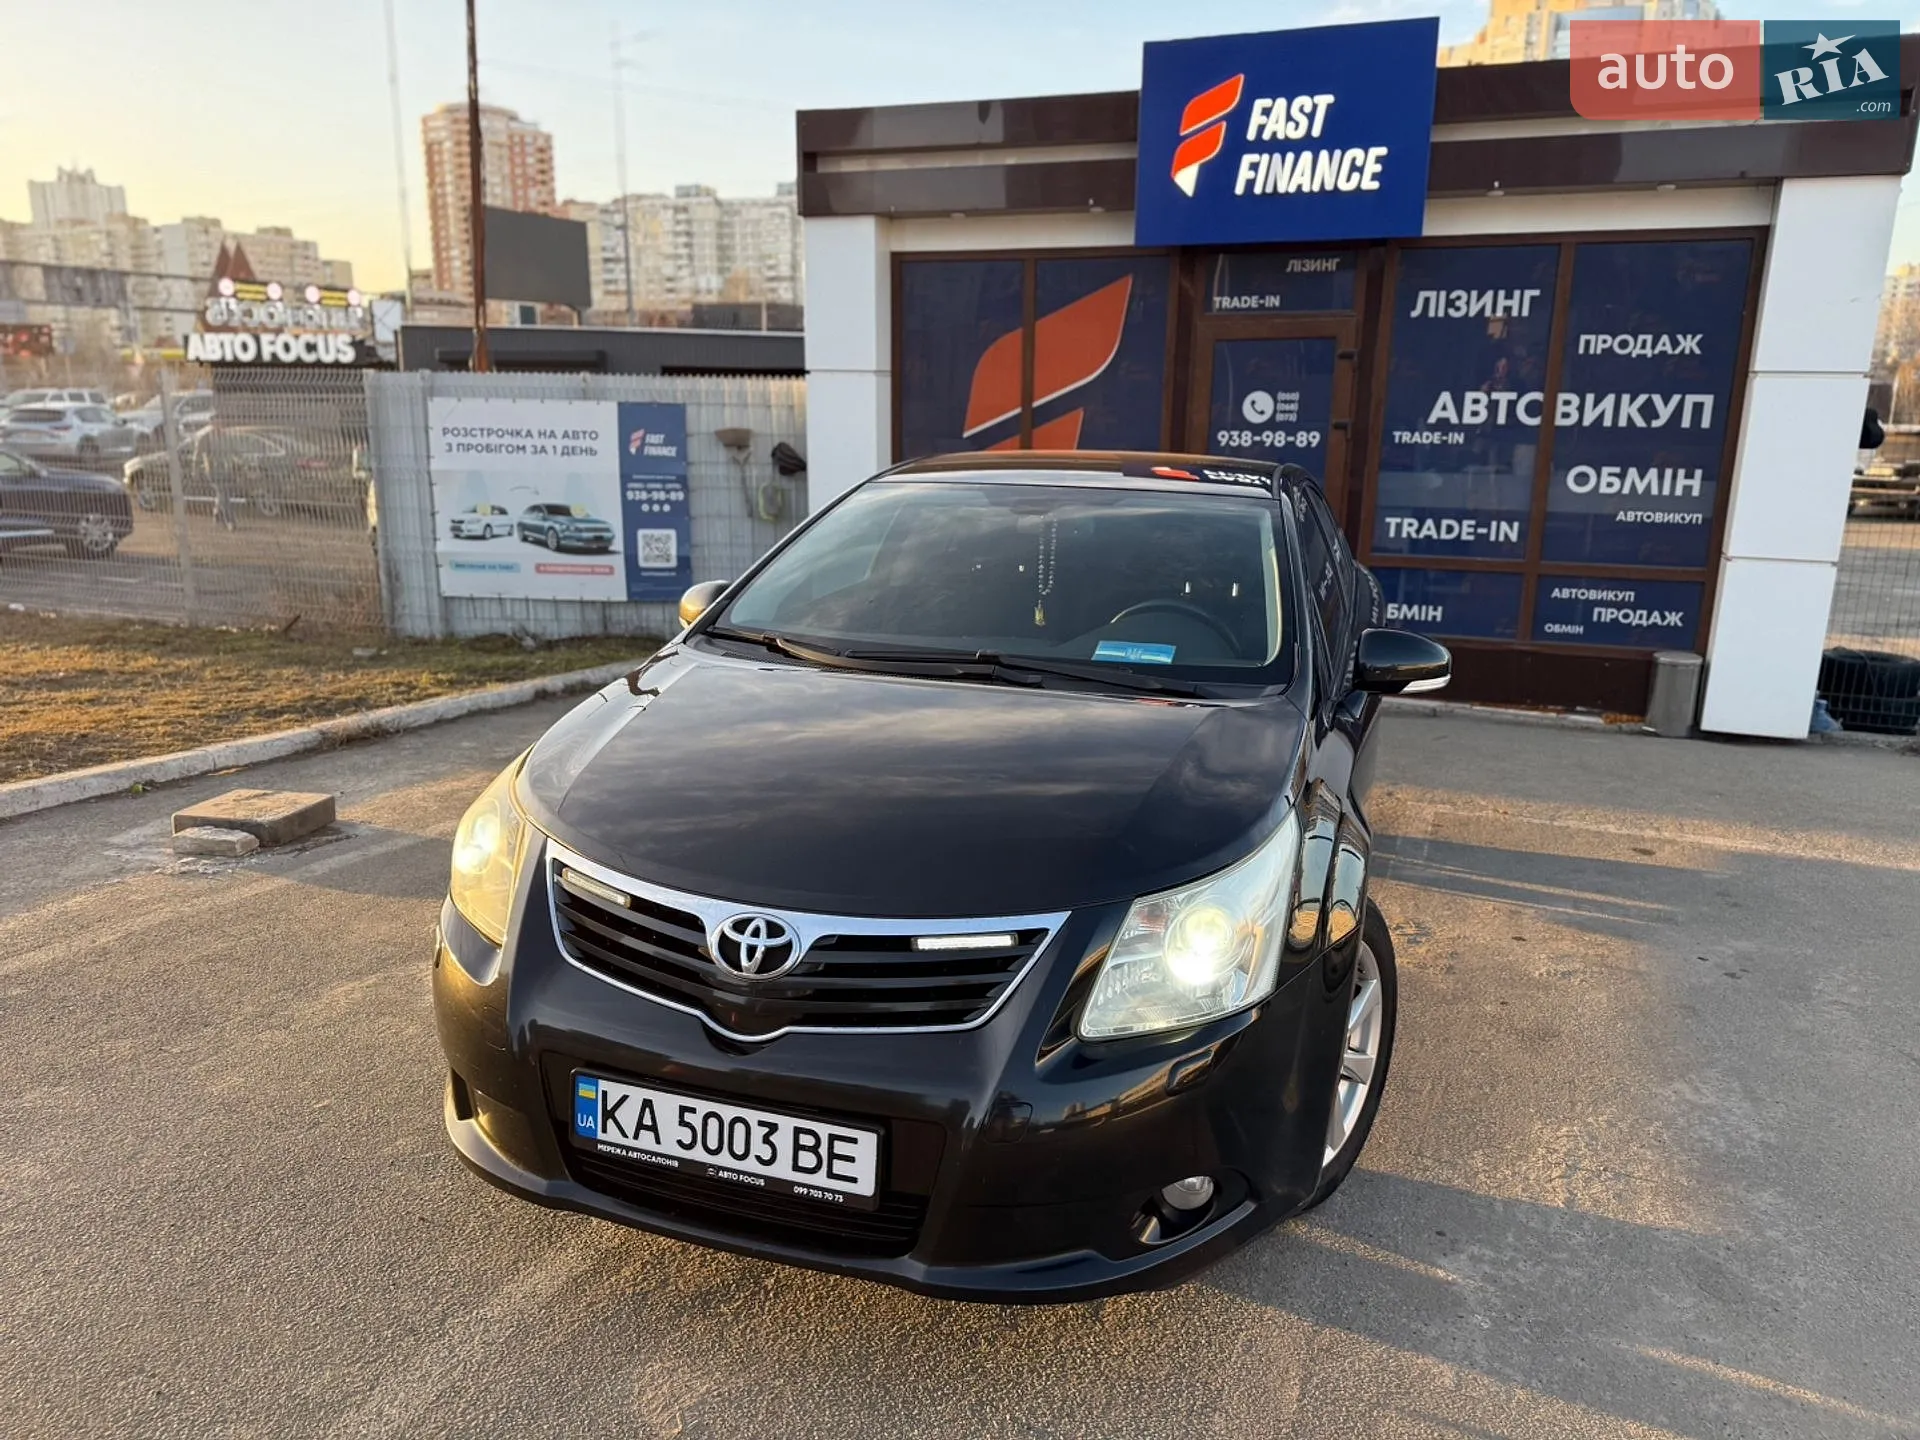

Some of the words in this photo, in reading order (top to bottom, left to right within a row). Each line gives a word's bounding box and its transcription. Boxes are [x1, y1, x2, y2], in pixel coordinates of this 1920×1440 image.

[1246, 94, 1335, 142] FAST
[1234, 146, 1388, 196] FINANCE
[1286, 258, 1340, 273] ЛІЗИНГ
[1213, 295, 1280, 310] TRADE-IN
[1410, 289, 1540, 318] ЛІЗИНГ
[187, 333, 257, 363] АВТО
[260, 333, 356, 364] FOCUS
[1578, 334, 1704, 358] ПРОДАЖ
[1427, 390, 1715, 430] АВТОВИКУП
[442, 426, 532, 440] РОЗСТРОЧКА
[538, 428, 558, 440] НА
[563, 428, 599, 442] АВТО
[1217, 430, 1320, 448] 938-98-89
[1393, 432, 1464, 444] TRADE-IN
[457, 442, 526, 456] ПРОБІГОМ
[531, 444, 548, 456] ЗА
[552, 444, 558, 456] 1
[560, 444, 598, 458] ДЕНЬ
[1566, 464, 1704, 497] ОБМІН
[626, 490, 684, 502] 938-98-89
[1616, 510, 1702, 525] АВТОВИКУП
[1385, 517, 1520, 543] TRADE-IN
[1551, 588, 1635, 602] АВТОВИКУП
[1386, 603, 1442, 622] БМІН
[1592, 607, 1684, 628] ПРОДАЖ
[1544, 623, 1584, 635] ОБМІН
[578, 1114, 595, 1130] UA
[601, 1090, 662, 1145] KA
[676, 1105, 778, 1166] 5003
[792, 1126, 858, 1184] BE
[598, 1143, 627, 1156] МЕРЕЖА
[628, 1150, 678, 1168] АВТОСАЛОНІВ
[718, 1170, 738, 1181] АВТО
[739, 1174, 765, 1186] FOCUS
